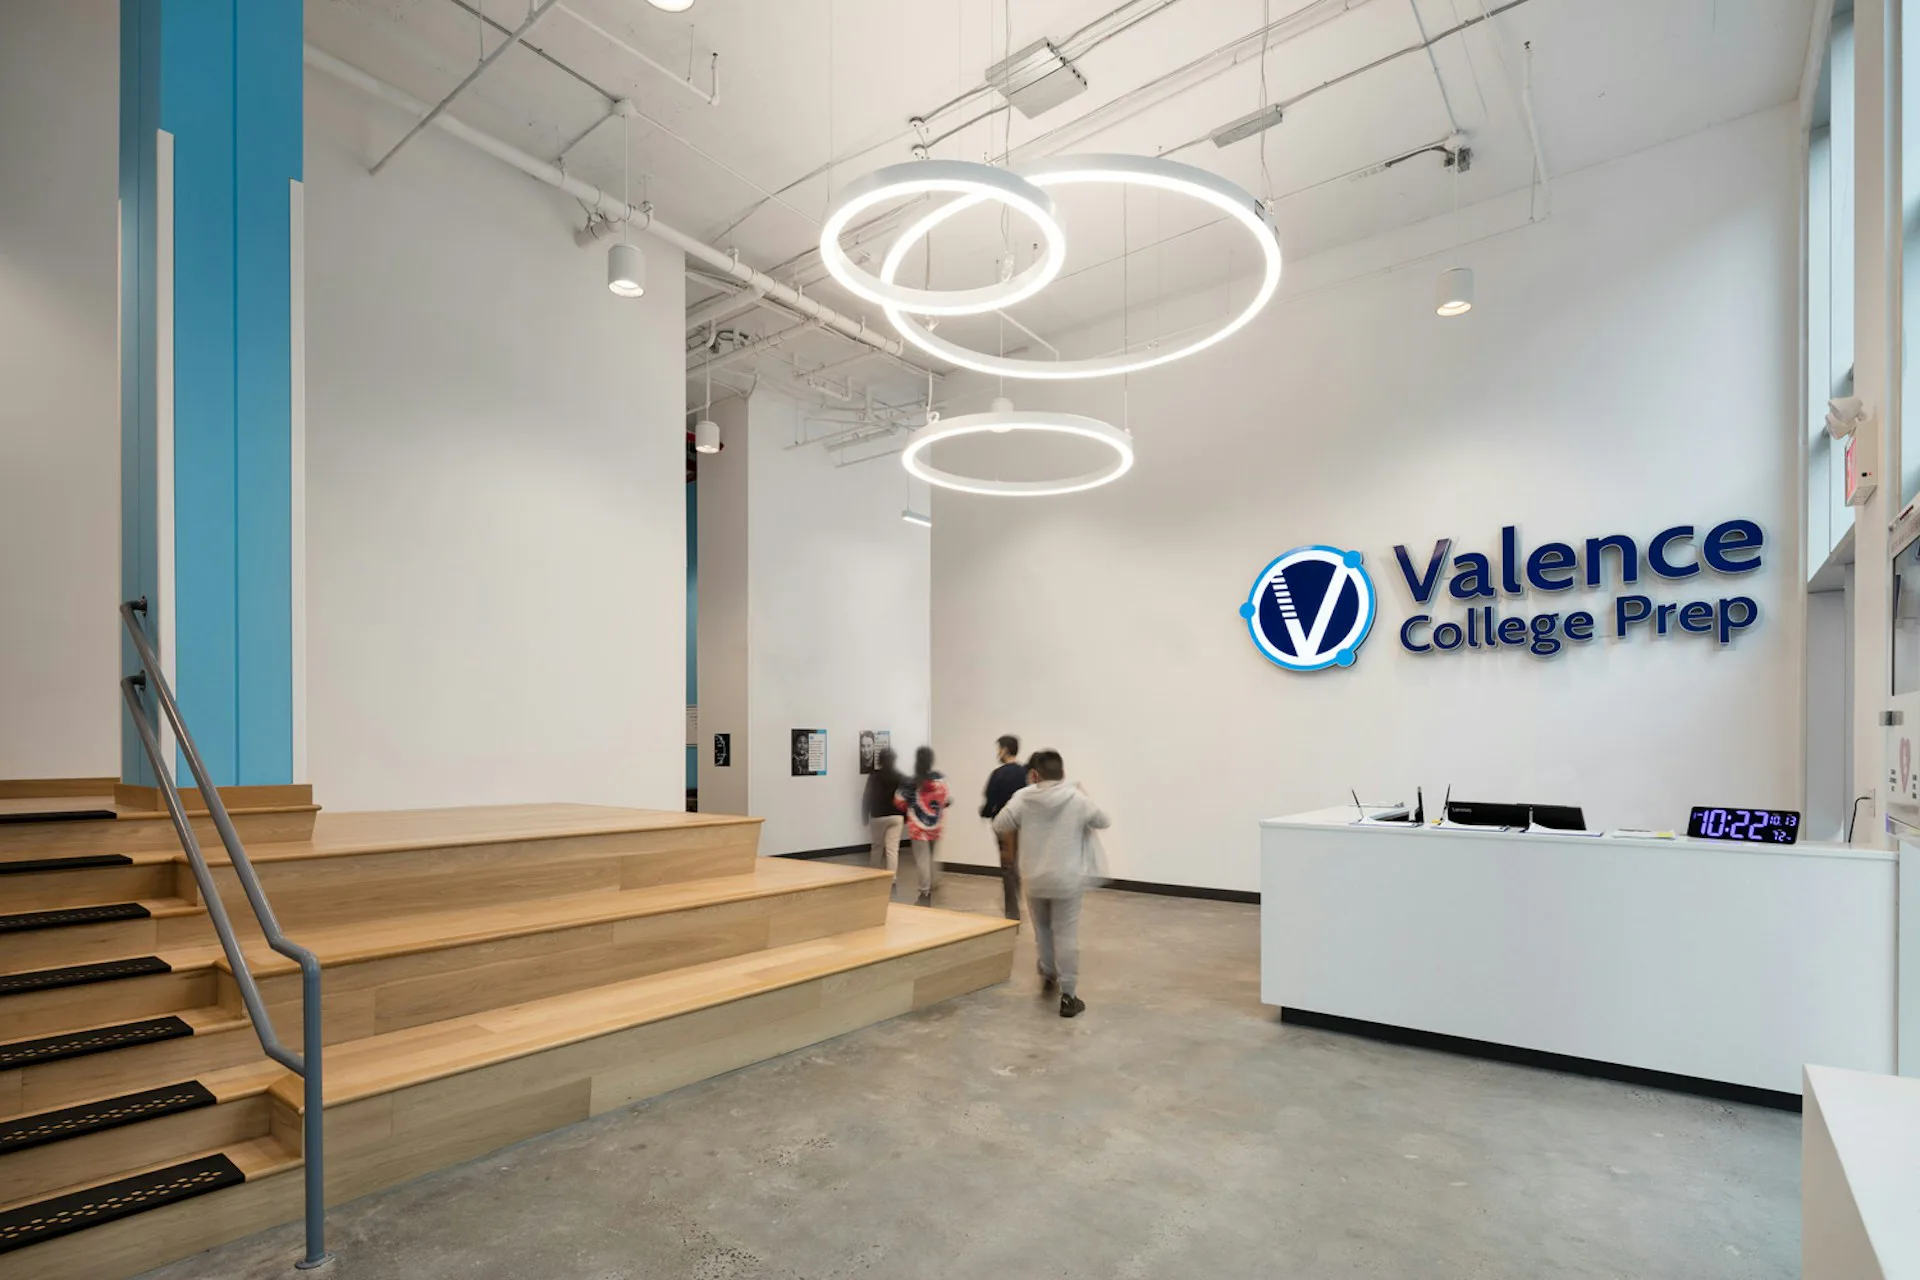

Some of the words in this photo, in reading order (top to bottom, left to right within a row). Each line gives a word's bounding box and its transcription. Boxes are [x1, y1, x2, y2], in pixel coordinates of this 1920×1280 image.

[1393, 517, 1764, 604] Valence
[1400, 606, 1594, 656] College
[1615, 594, 1758, 645] Prep
[1697, 809, 1769, 840] 10:22
